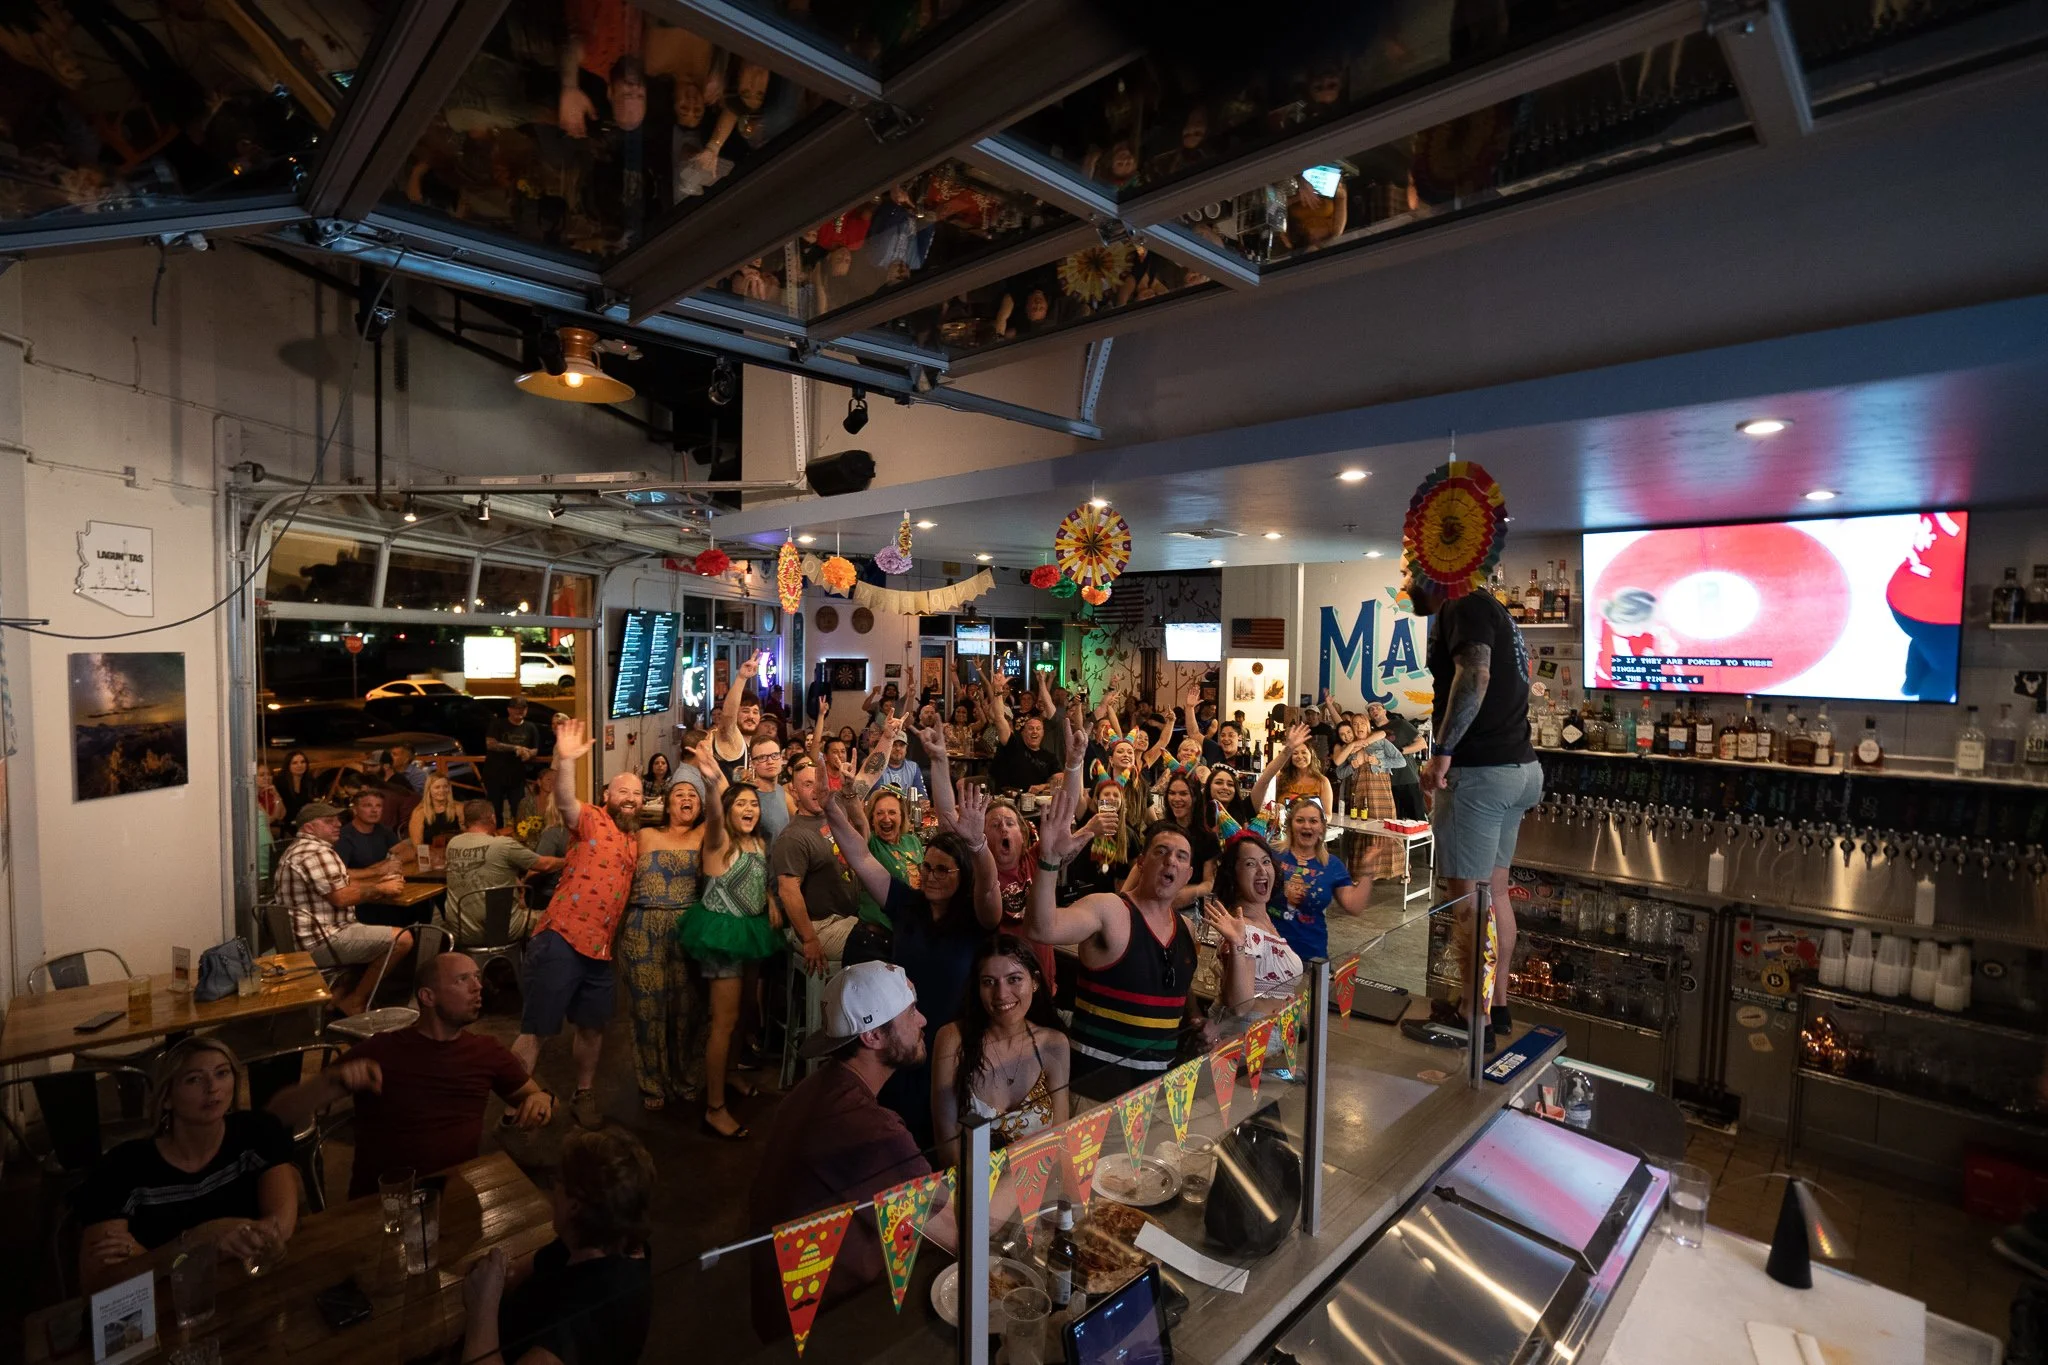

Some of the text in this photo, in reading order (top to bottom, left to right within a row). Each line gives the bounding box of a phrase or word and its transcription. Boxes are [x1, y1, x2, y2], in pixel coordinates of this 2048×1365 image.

[97, 550, 143, 562] LAGUNTAS
[1317, 598, 1438, 705] MA
[1687, 658, 1722, 666] FORCED
[1725, 659, 1739, 667] TO
[462, 844, 490, 859] CITY
